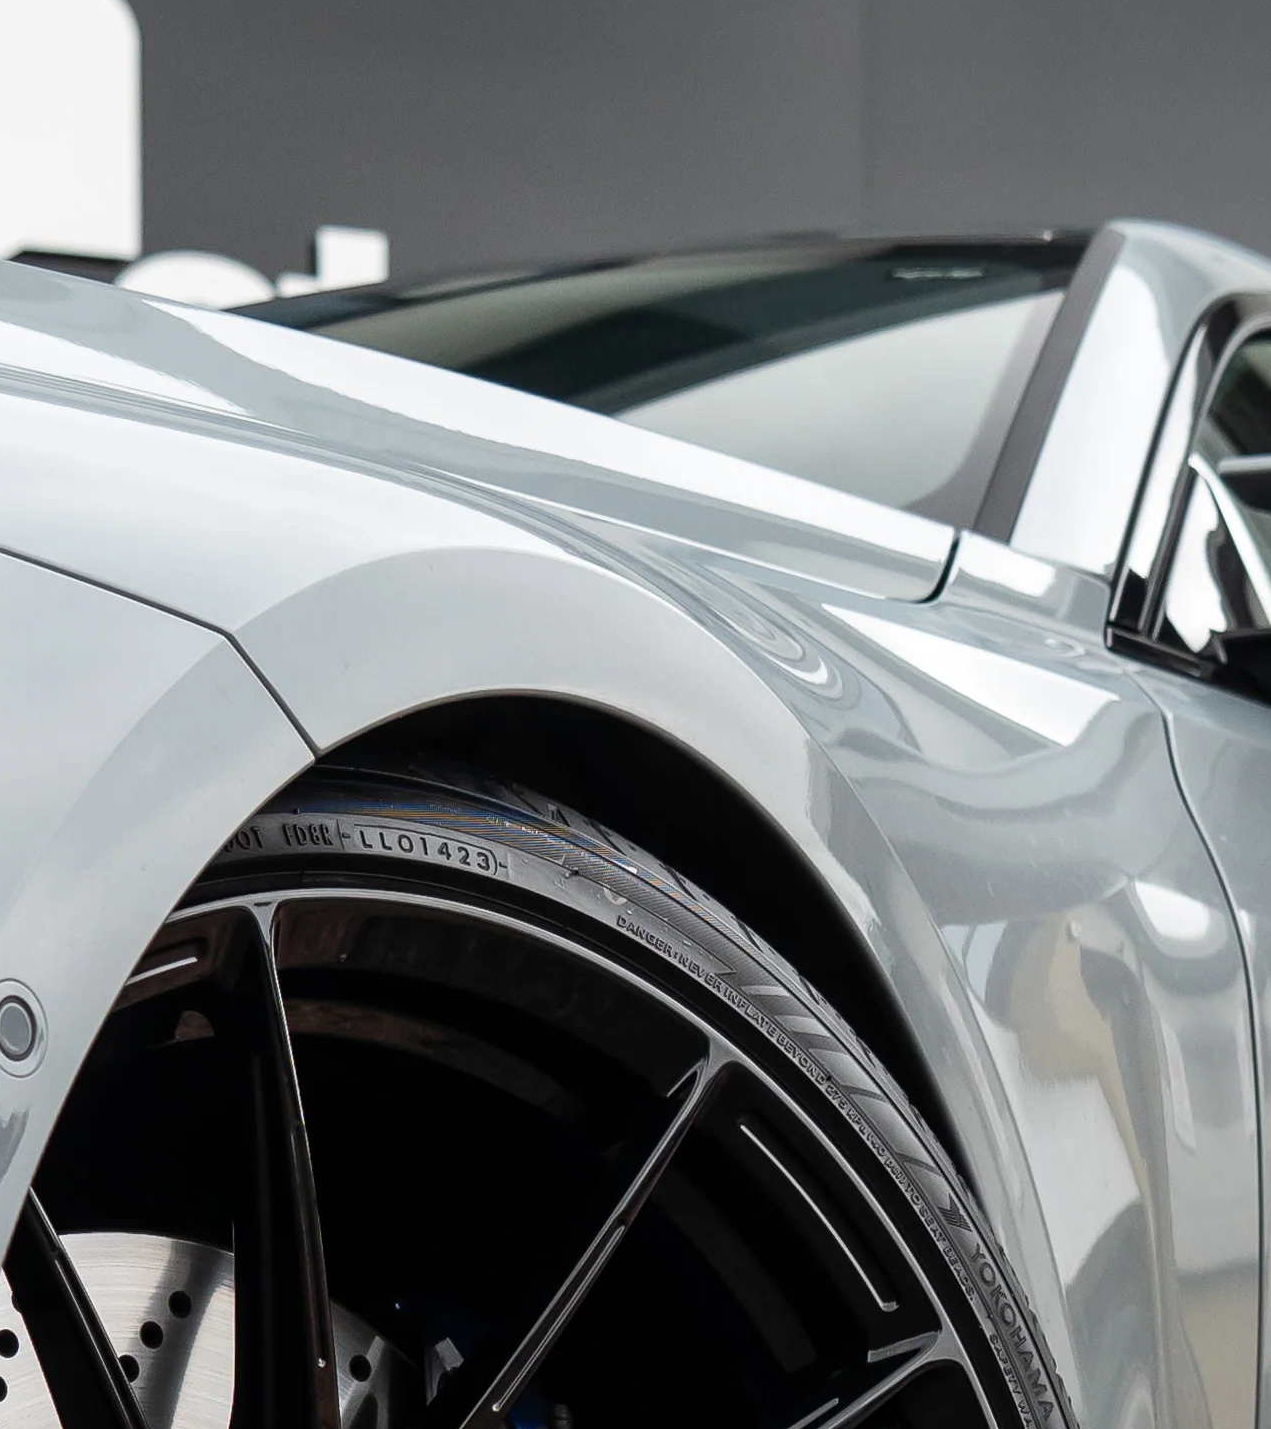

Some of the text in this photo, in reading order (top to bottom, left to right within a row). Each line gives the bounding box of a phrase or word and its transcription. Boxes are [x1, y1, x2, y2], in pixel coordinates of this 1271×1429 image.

[677, 951, 725, 993] NEVER
[722, 985, 778, 1038] INFLATE
[775, 1032, 828, 1087] BEYOND
[824, 1081, 849, 1111] 275
[903, 1182, 923, 1207] TO
[917, 1203, 947, 1245] SEAT
[970, 1243, 1056, 1422] YOKOHAMA
[987, 1331, 1022, 1397] SAFETY
